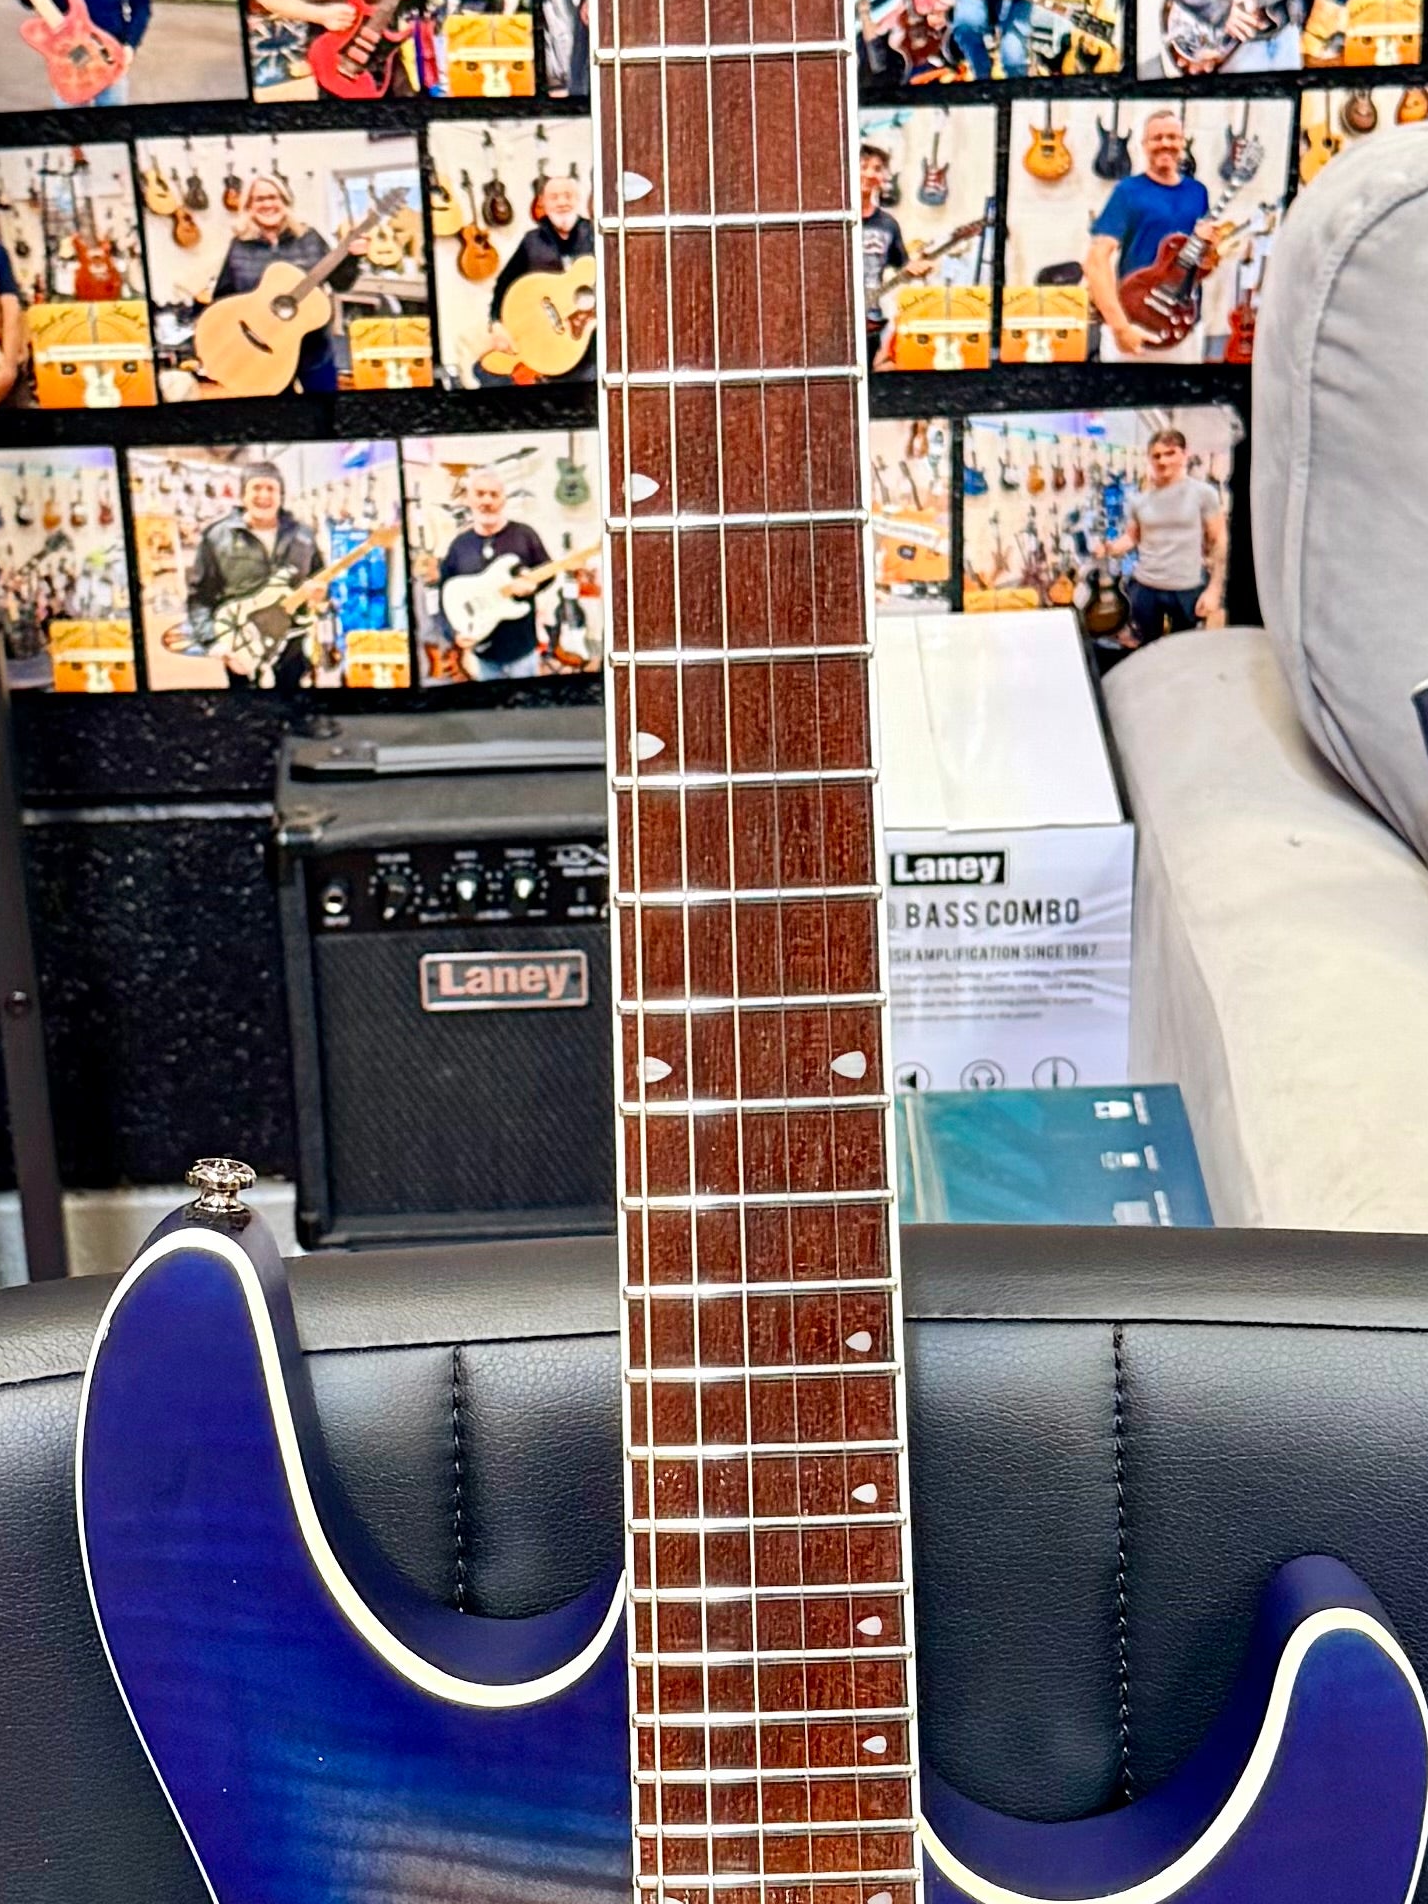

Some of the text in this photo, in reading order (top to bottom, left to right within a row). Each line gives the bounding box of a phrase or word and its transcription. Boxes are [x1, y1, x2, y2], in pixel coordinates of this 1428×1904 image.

[894, 854, 1001, 884] Laney
[906, 901, 980, 928] BASS
[986, 899, 1081, 926] COMBO
[914, 945, 1020, 962] AMPLIFICATION
[1023, 945, 1062, 961] SINCE
[438, 962, 571, 999] Laney
